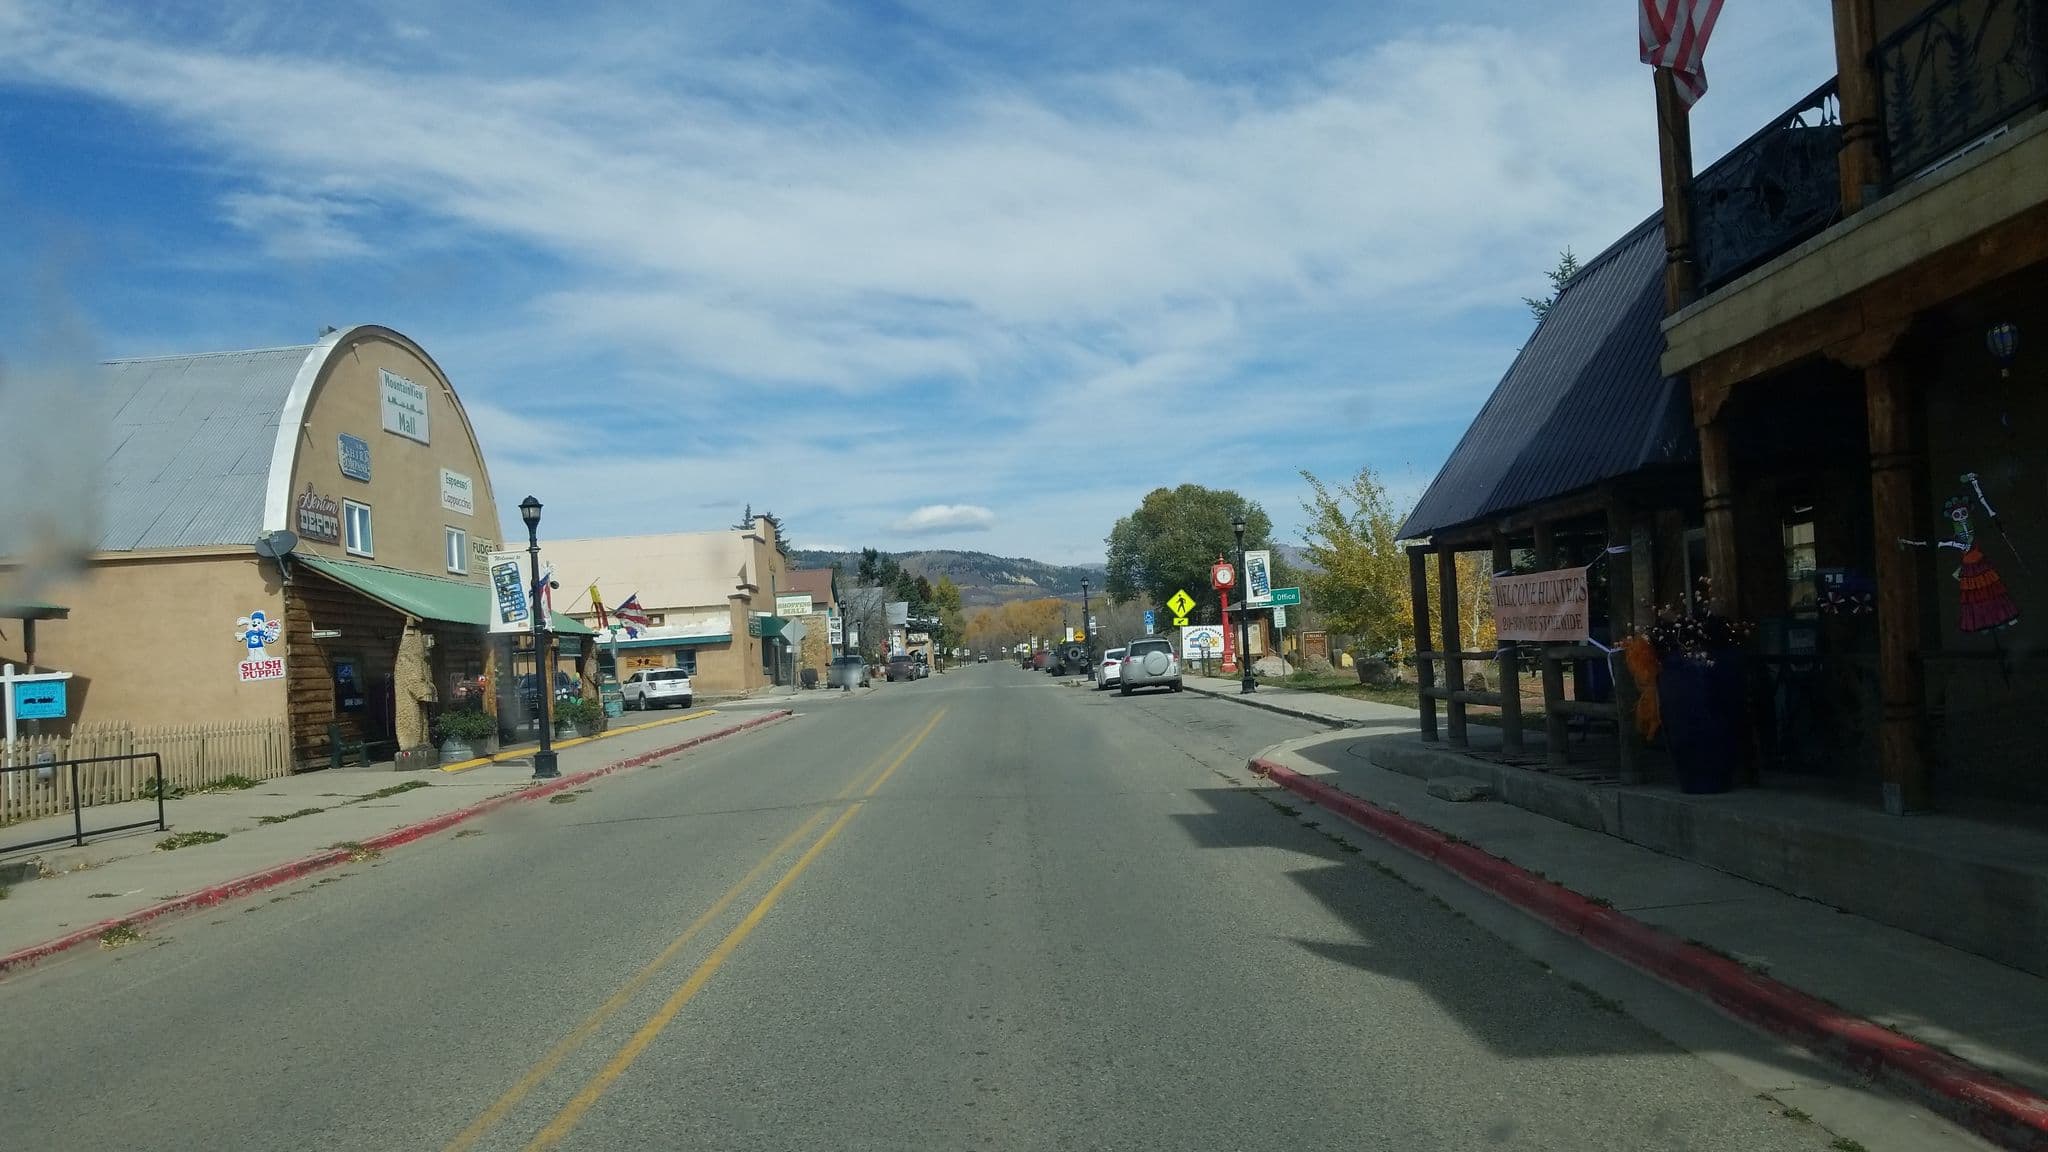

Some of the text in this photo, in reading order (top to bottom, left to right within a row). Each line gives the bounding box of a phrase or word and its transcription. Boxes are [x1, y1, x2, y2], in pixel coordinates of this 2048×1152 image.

[399, 411, 416, 435] Mall
[445, 472, 468, 490] Espresso
[299, 483, 339, 513] Denim
[443, 490, 471, 510] Cappuccino
[300, 509, 338, 537] DEPOT
[472, 541, 493, 555] FUDGE
[1495, 577, 1587, 606] WELCOME HUNTERS
[250, 635, 259, 644] S
[241, 660, 282, 672] SLUSH
